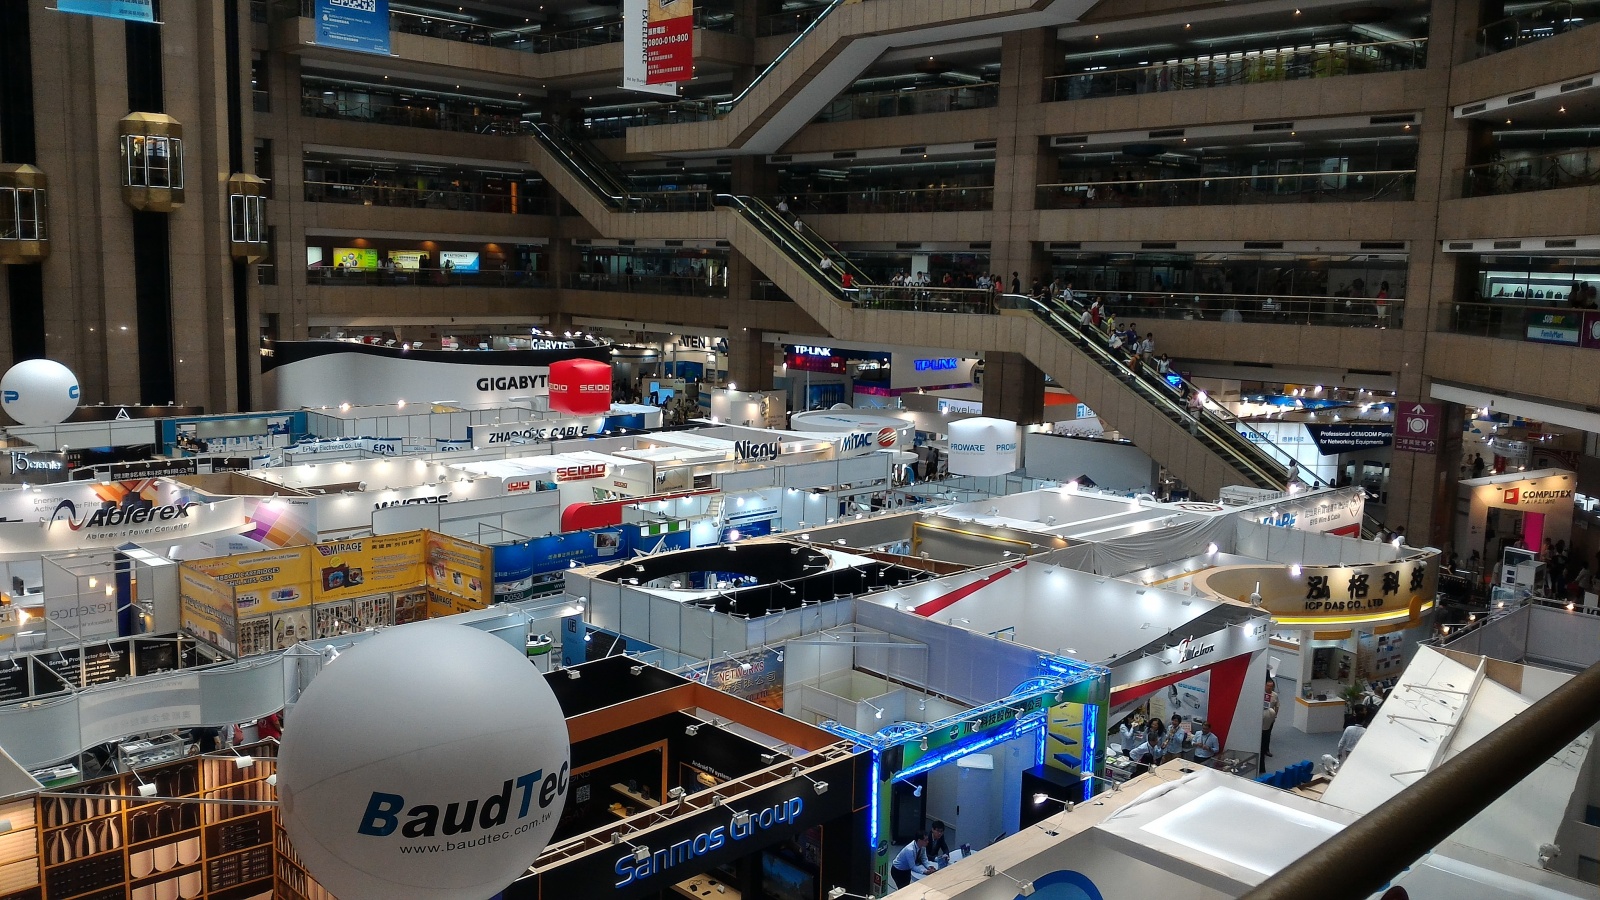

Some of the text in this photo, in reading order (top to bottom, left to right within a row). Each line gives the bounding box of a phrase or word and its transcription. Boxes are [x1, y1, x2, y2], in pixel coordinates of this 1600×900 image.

[1541, 330, 1563, 338] FamilyMart
[679, 335, 706, 349] ATEN
[794, 345, 831, 357] TP-LINK
[914, 358, 957, 372] TP-LINK
[477, 375, 549, 392] GIGABYT
[551, 425, 588, 437] CABLE
[1320, 430, 1350, 438] Professional
[951, 444, 985, 452] PROWARE
[557, 464, 606, 477] SEIDIO
[1522, 490, 1572, 499] COMPUTEX
[86, 503, 198, 527] Ablerex
[86, 532, 118, 540] Ablerex
[128, 528, 153, 537] Power
[154, 523, 190, 533] Converter
[330, 542, 362, 554] MIRAGE
[1306, 565, 1425, 600] 泓格科技
[1305, 601, 1322, 610] ICP
[1324, 601, 1345, 610] DAS
[1367, 598, 1384, 607] LTD
[357, 760, 568, 837] BaudTec
[400, 810, 552, 855] www.baudtec.com.tw
[614, 796, 803, 889] Sanmos Group
